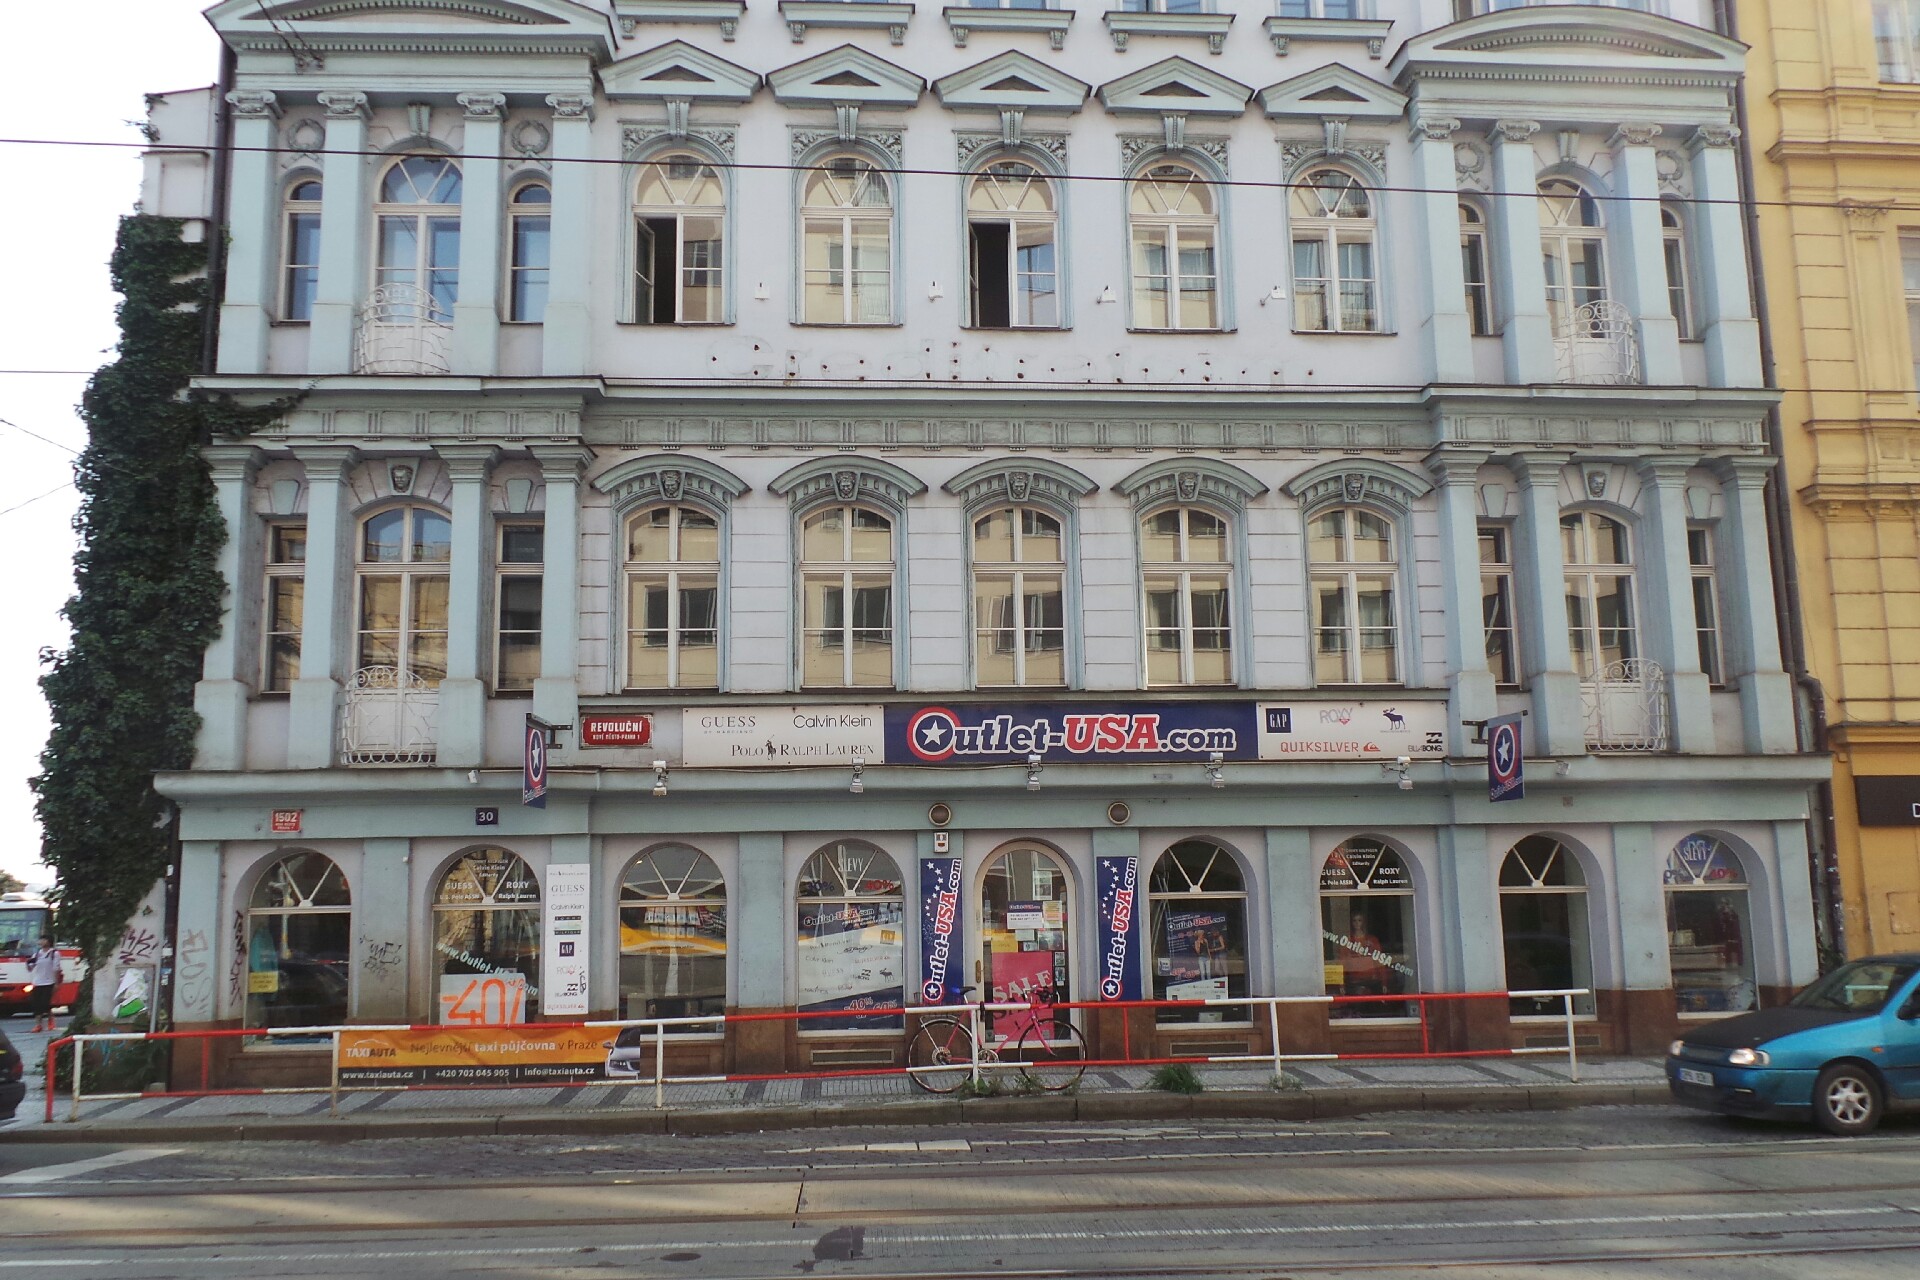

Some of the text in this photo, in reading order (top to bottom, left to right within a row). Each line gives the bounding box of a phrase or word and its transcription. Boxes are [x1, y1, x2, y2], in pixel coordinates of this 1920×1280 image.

[701, 716, 757, 728] GUESS
[793, 714, 872, 729] Calvin Klein
[1269, 713, 1287, 728] GAP
[1319, 707, 1353, 725] ROXY
[590, 720, 643, 732] REVOLUČNÍ
[906, 706, 1237, 762] Outlet-USA.com
[731, 743, 874, 757] POLO RALPH LAUREN
[1280, 741, 1359, 753] QUIKSILVER
[275, 812, 297, 822] 1502
[479, 812, 493, 821] 30
[1321, 868, 1346, 876] GUESS
[1379, 867, 1400, 875] ROXY
[445, 881, 473, 889] GUESS
[506, 881, 529, 889] ROXY
[551, 885, 585, 893] GUESS
[498, 893, 515, 901] Ralph
[922, 859, 961, 1003] Outlet-USA.com
[1100, 857, 1137, 1000] Outlet-USA.com
[561, 945, 573, 954] GAP
[1322, 929, 1414, 976] ww.Outlet-USA.com
[993, 970, 1053, 1003] SALE
[346, 1048, 396, 1058] TAXIAUTA
[475, 1042, 497, 1052] taxi
[500, 1041, 556, 1054] půjčovna
[567, 1040, 598, 1050] Praze
[342, 1070, 414, 1079] www.taxiauta.cz
[458, 1069, 474, 1077] 702
[524, 1067, 595, 1076] info@taxiauta.cz
